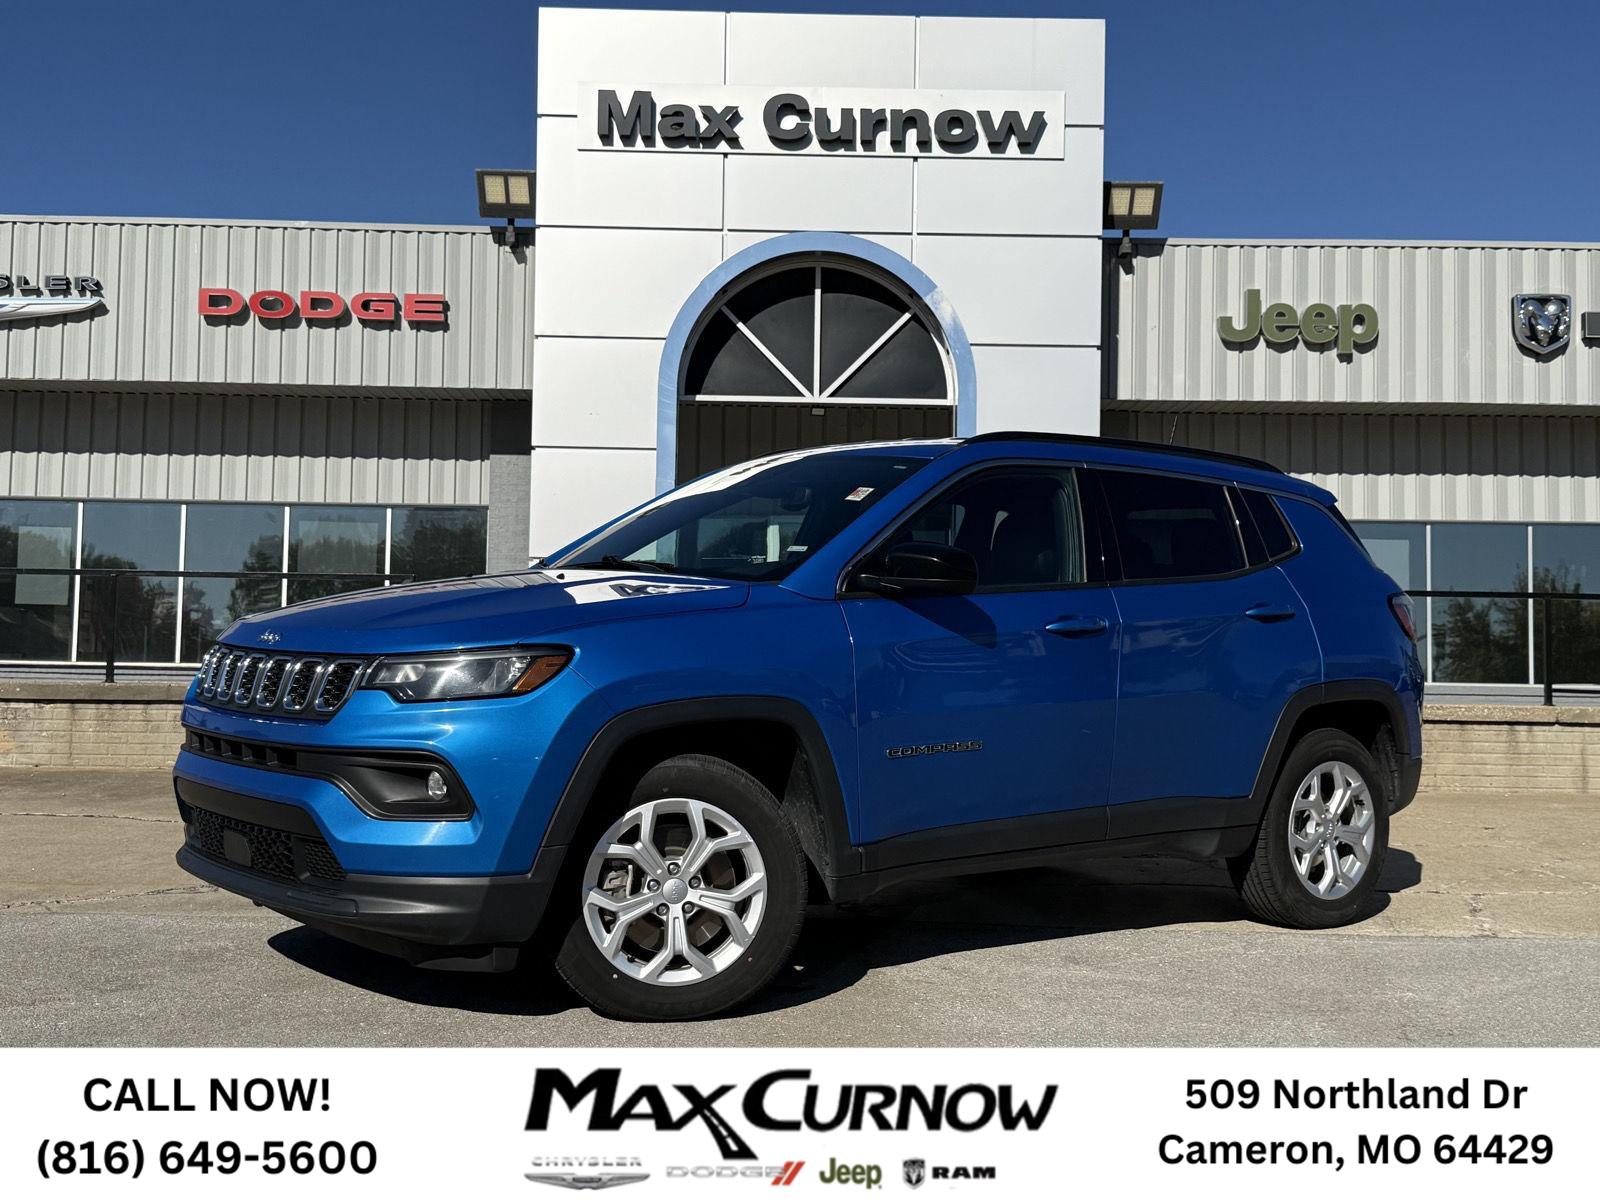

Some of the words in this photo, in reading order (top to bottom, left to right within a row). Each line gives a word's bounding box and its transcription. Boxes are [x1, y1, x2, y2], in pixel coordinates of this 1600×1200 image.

[597, 89, 740, 149] Max
[763, 93, 1045, 156] Curnow
[198, 287, 446, 323] DODGE
[1217, 288, 1379, 355] Jeep
[886, 740, 983, 759] COMPASS
